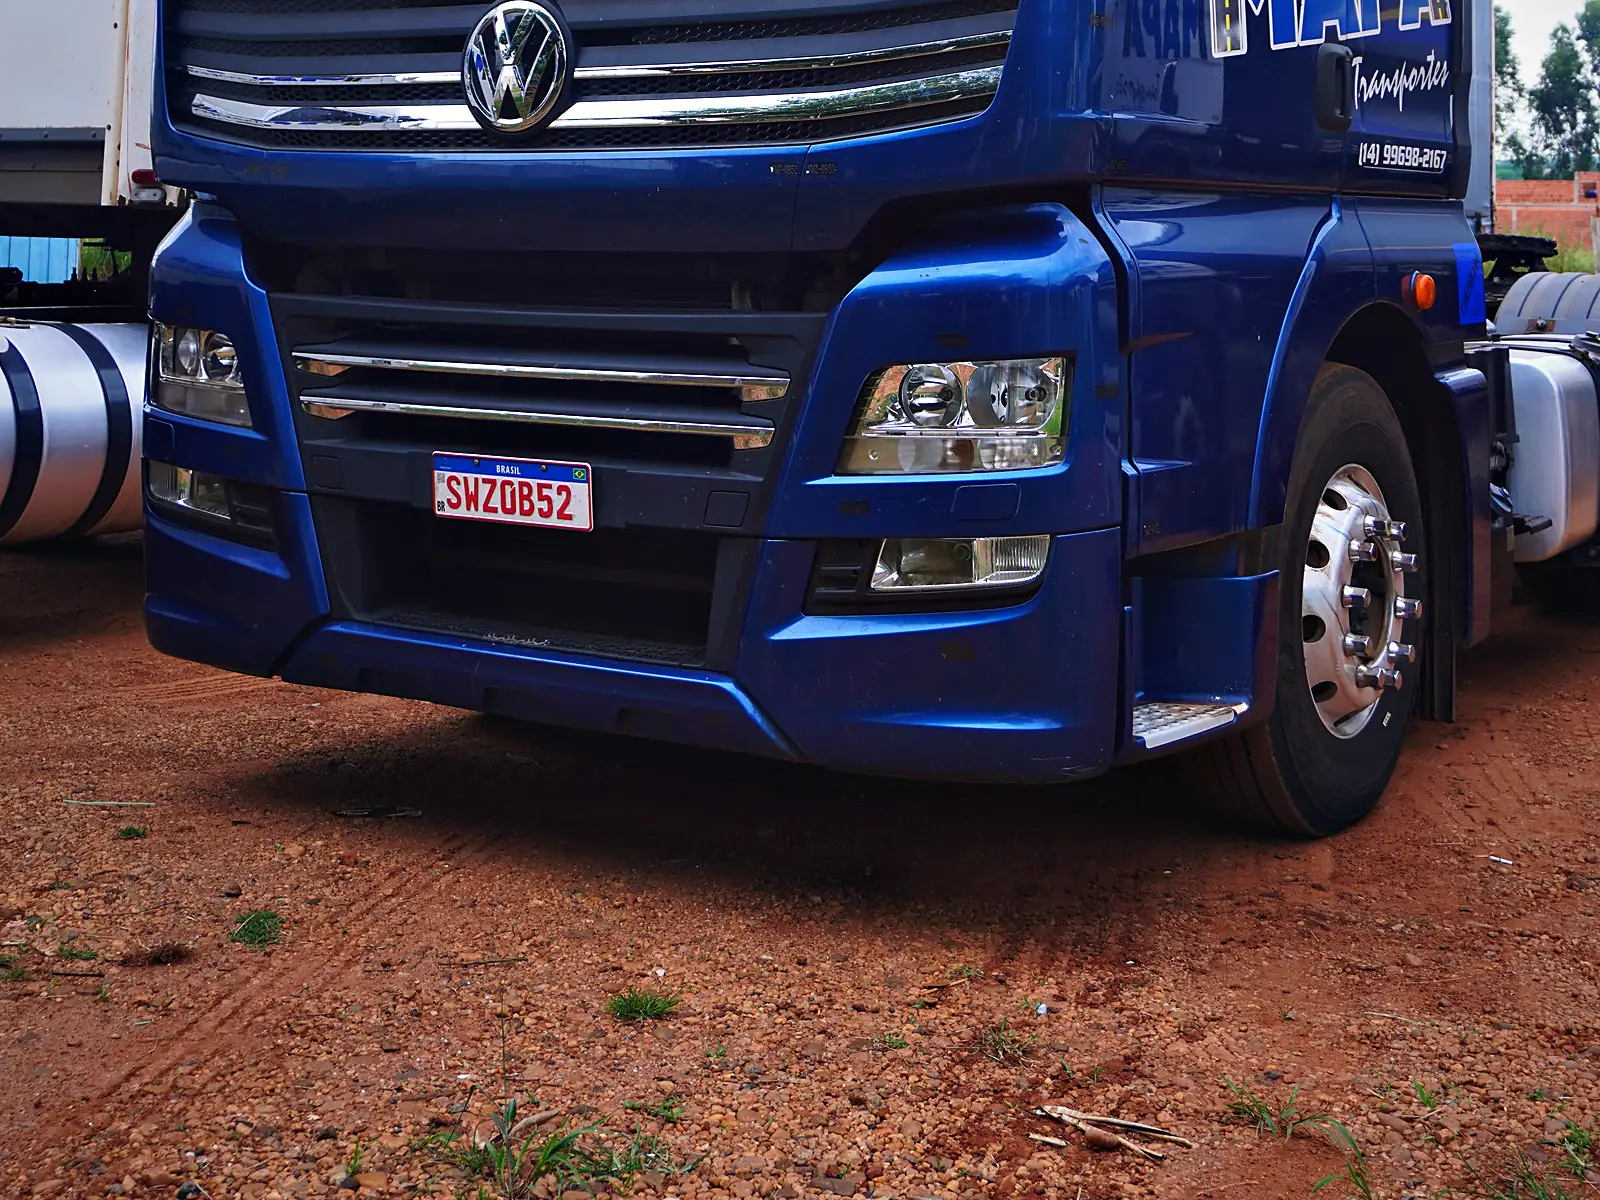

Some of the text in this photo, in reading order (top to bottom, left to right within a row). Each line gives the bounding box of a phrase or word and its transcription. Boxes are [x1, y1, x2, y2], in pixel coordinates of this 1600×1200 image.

[1351, 48, 1450, 113] Transportes
[1358, 142, 1448, 170] (14) 99698-2167
[495, 464, 522, 476] BRASIL
[436, 500, 446, 513] BR
[446, 474, 574, 522] SWZ0B52
